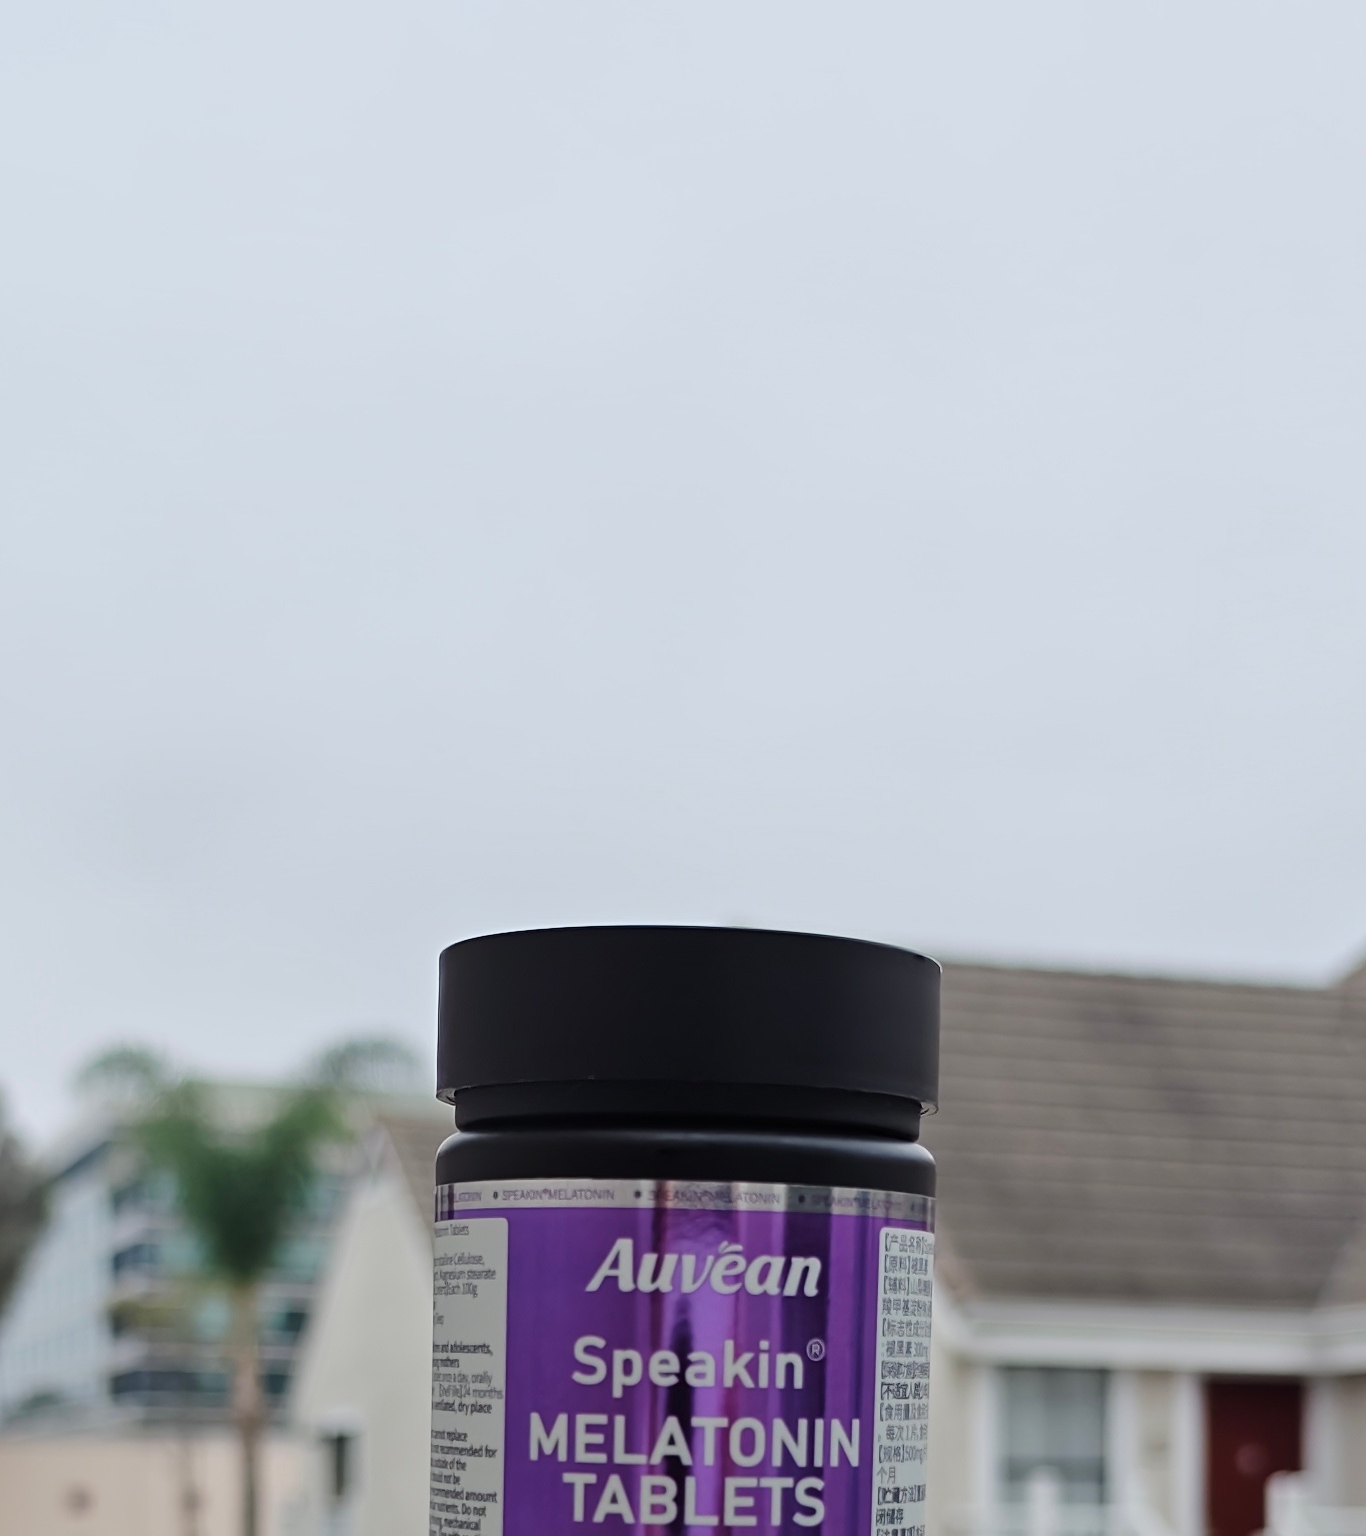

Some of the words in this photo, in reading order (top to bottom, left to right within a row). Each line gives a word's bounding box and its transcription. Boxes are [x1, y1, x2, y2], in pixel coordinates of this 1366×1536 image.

[471, 1400, 492, 1416] place
[528, 1411, 861, 1468] MELATONIN
[485, 1444, 498, 1458] for
[877, 1466, 896, 1485] 个月
[562, 1472, 826, 1527] TABLETS
[462, 1502, 472, 1516] Do
[473, 1506, 486, 1518] not
